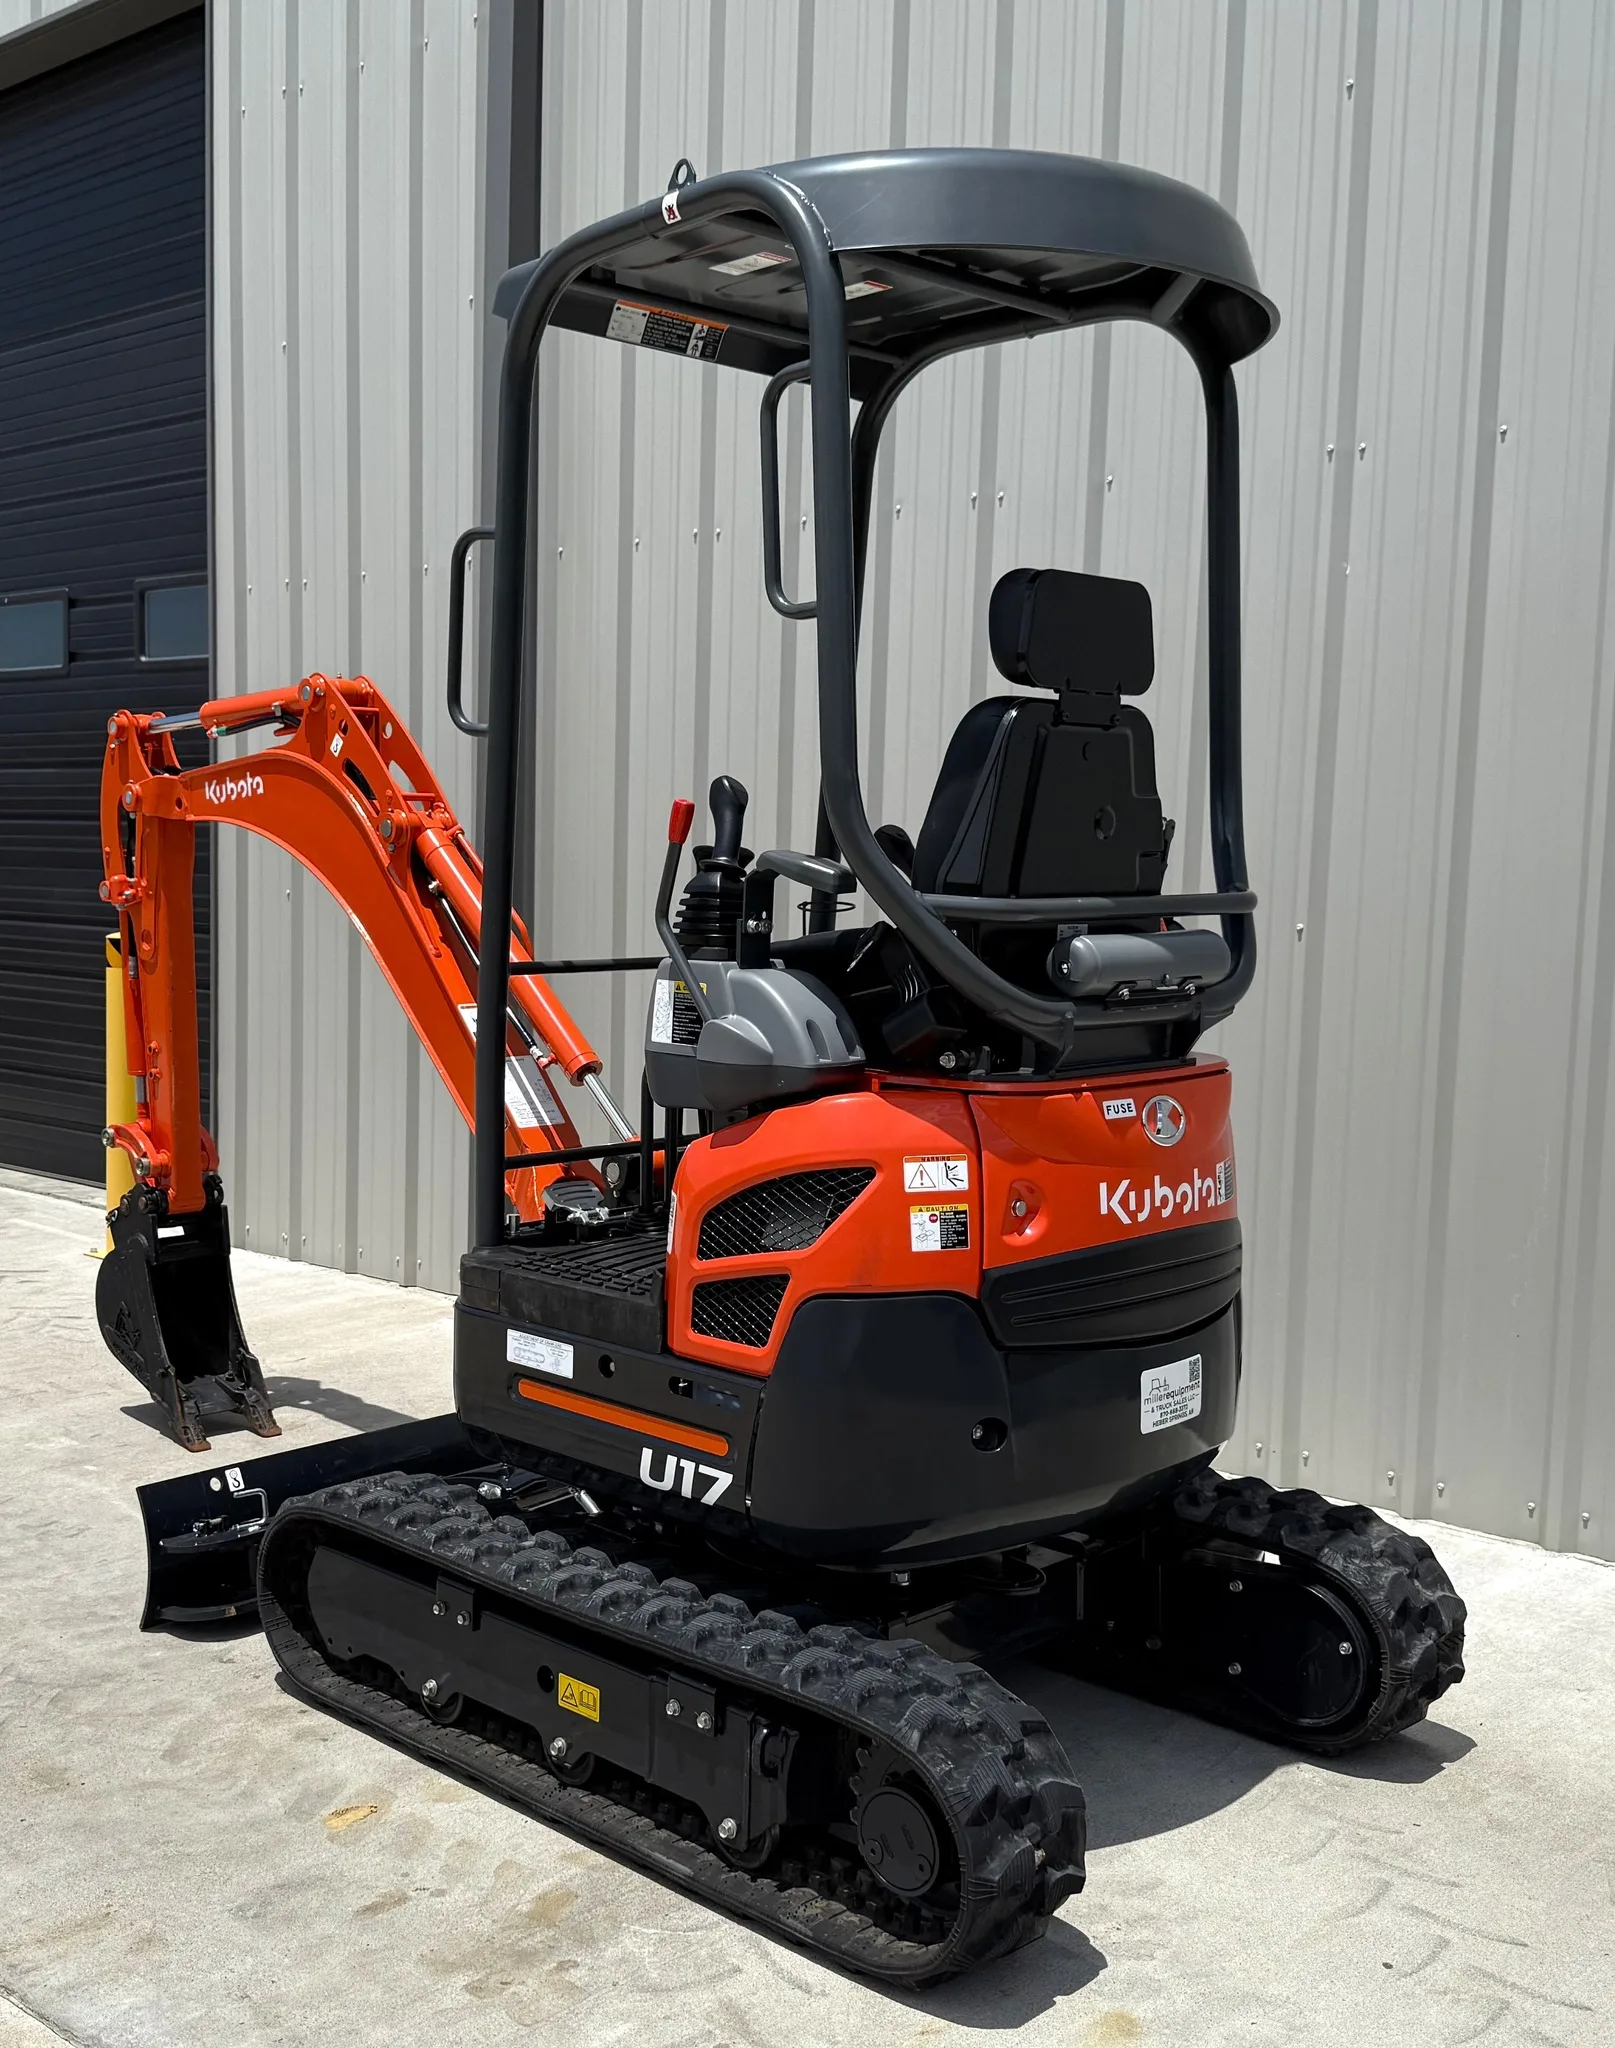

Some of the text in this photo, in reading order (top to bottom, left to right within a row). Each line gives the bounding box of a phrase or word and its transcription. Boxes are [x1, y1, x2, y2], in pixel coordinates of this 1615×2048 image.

[205, 771, 265, 805] Kubota
[1105, 1102, 1134, 1116] FUSE
[1099, 1167, 1216, 1225] Kubota
[1156, 1402, 1172, 1412] TRUCK
[1173, 1397, 1187, 1407] SALES
[640, 1447, 734, 1506] U17
